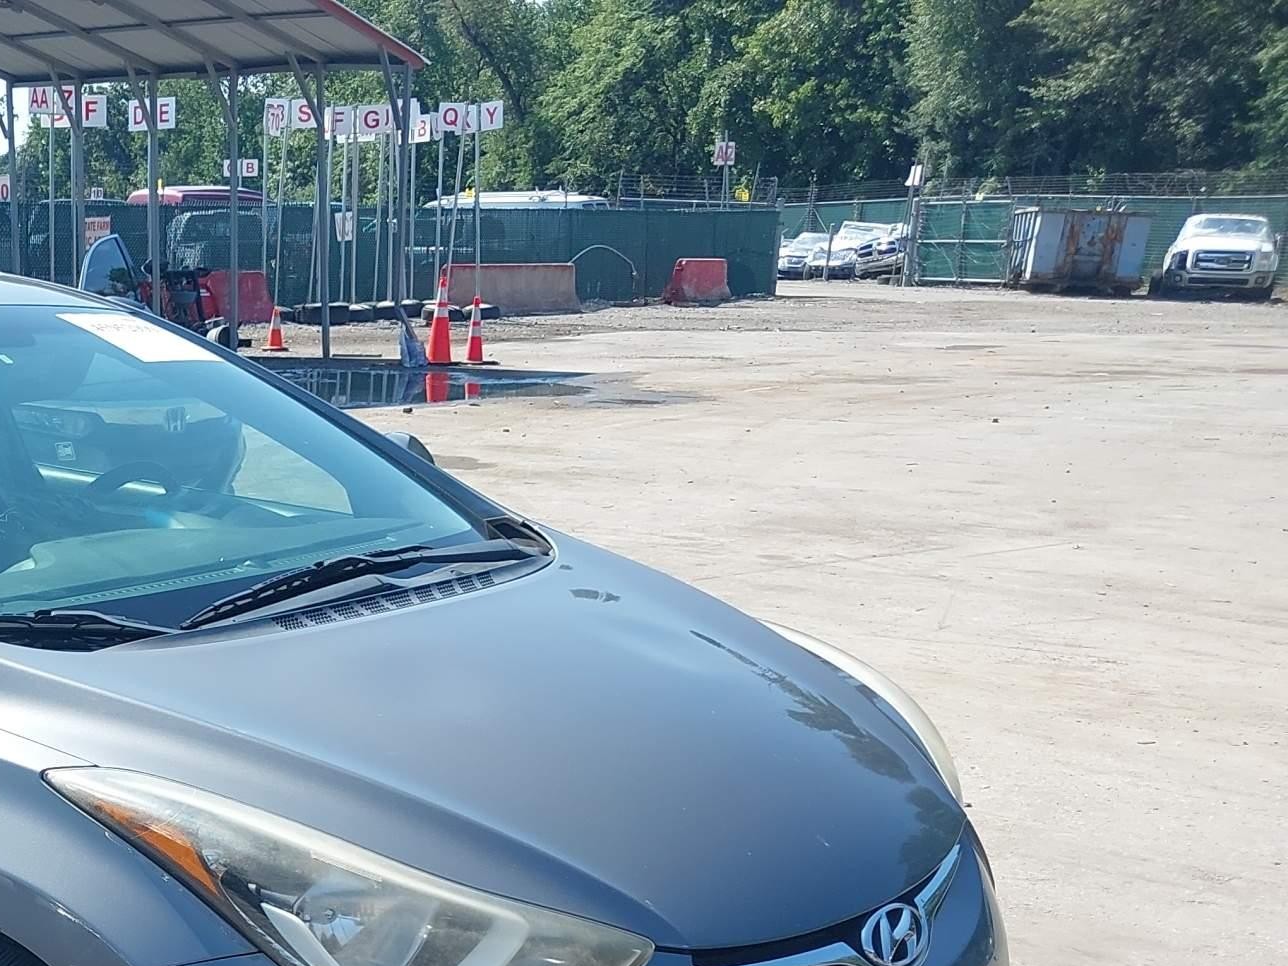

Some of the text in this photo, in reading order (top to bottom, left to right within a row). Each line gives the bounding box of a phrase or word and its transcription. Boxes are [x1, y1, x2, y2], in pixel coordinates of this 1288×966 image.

[30, 87, 49, 109] AA
[85, 100, 98, 121] F
[133, 106, 144, 125] D
[160, 103, 170, 123] E
[298, 104, 312, 123] S
[363, 110, 380, 129] G
[443, 107, 459, 127] Q
[486, 106, 498, 125] Y
[246, 162, 255, 174] B
